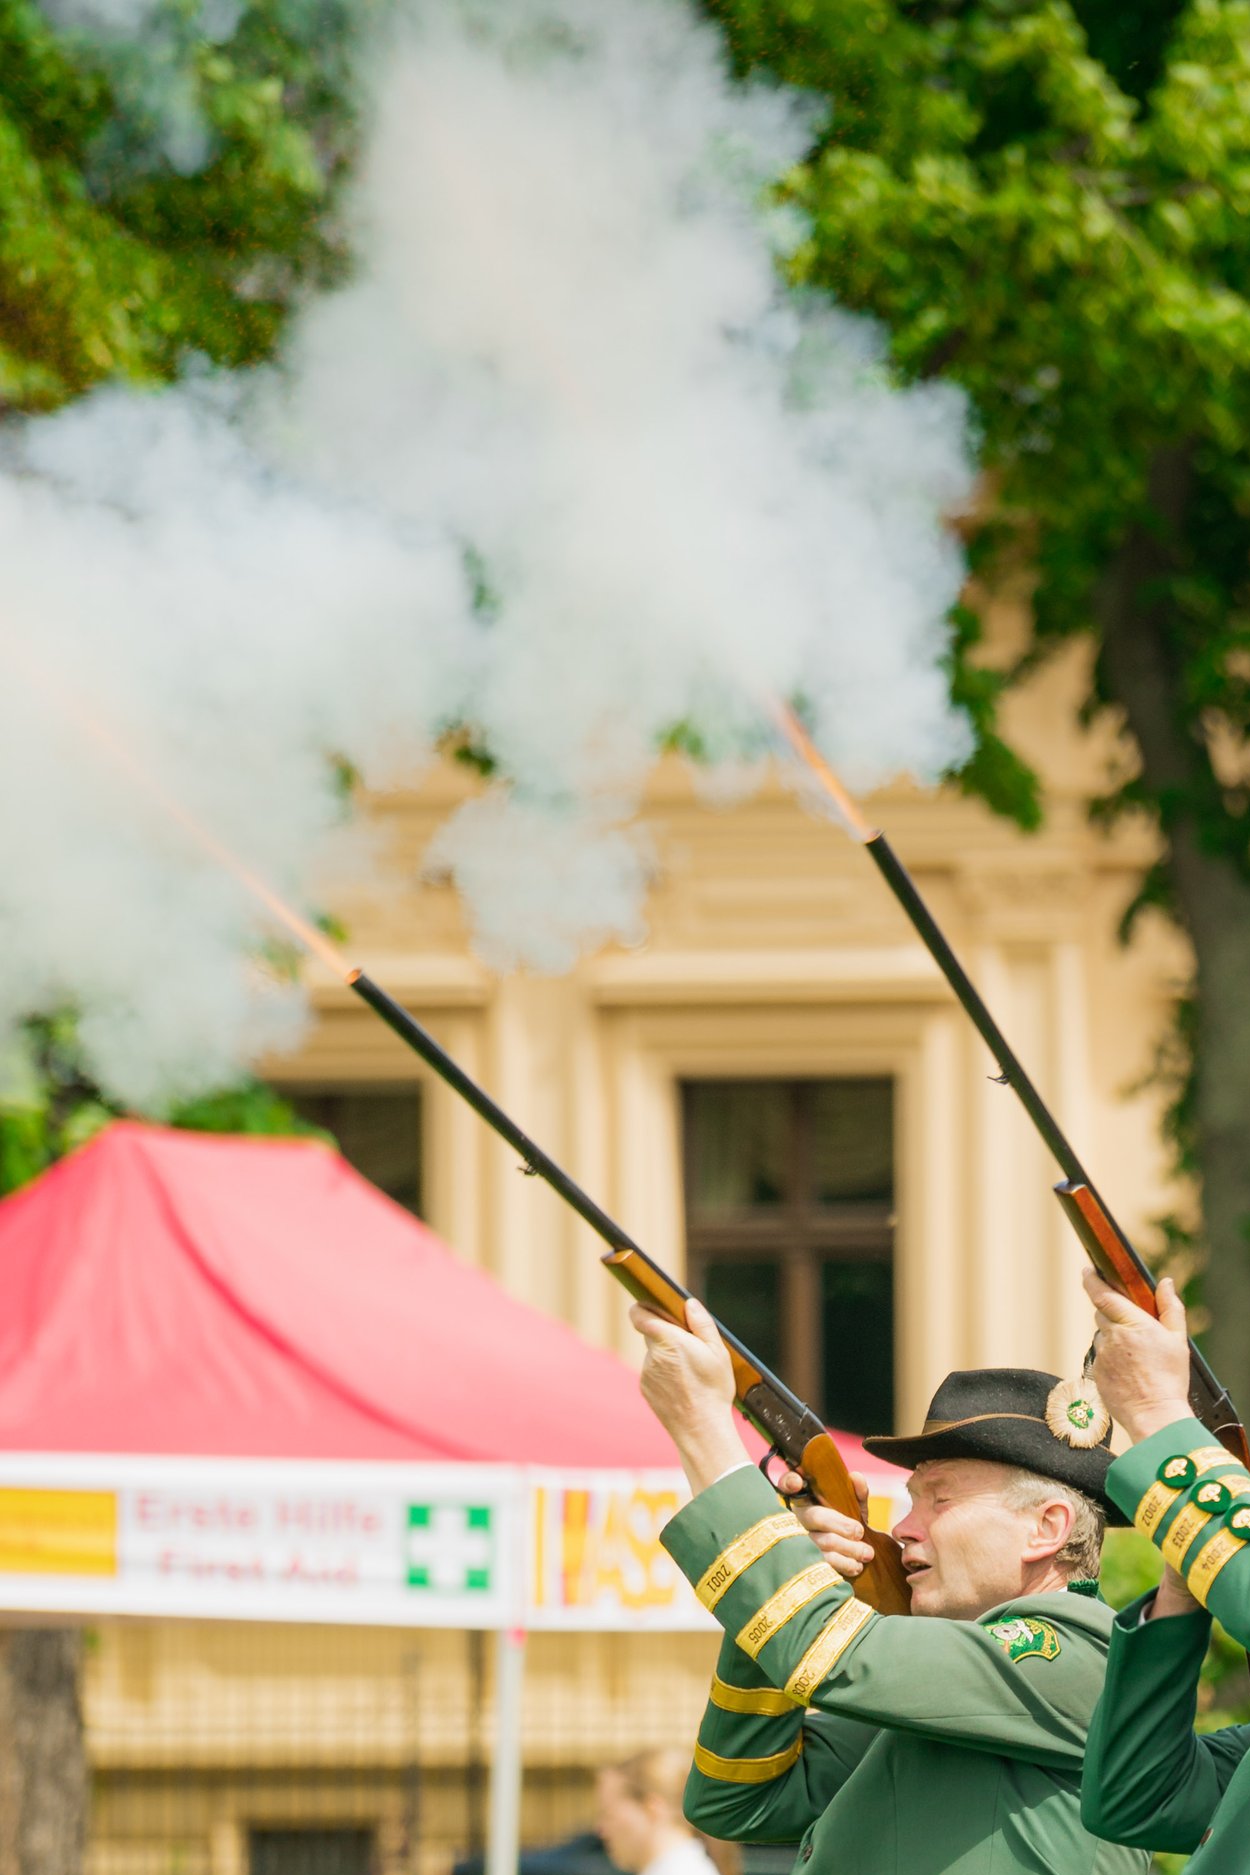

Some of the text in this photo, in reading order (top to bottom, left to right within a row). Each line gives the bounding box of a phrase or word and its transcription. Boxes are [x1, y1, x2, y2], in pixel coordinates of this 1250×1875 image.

[1141, 1496, 1162, 1527] 2002
[1172, 1517, 1194, 1549] 2003
[1202, 1540, 1228, 1571] 2004
[706, 1564, 732, 1593] 2001
[748, 1616, 774, 1644] 2005
[792, 1669, 816, 1697] 2008
